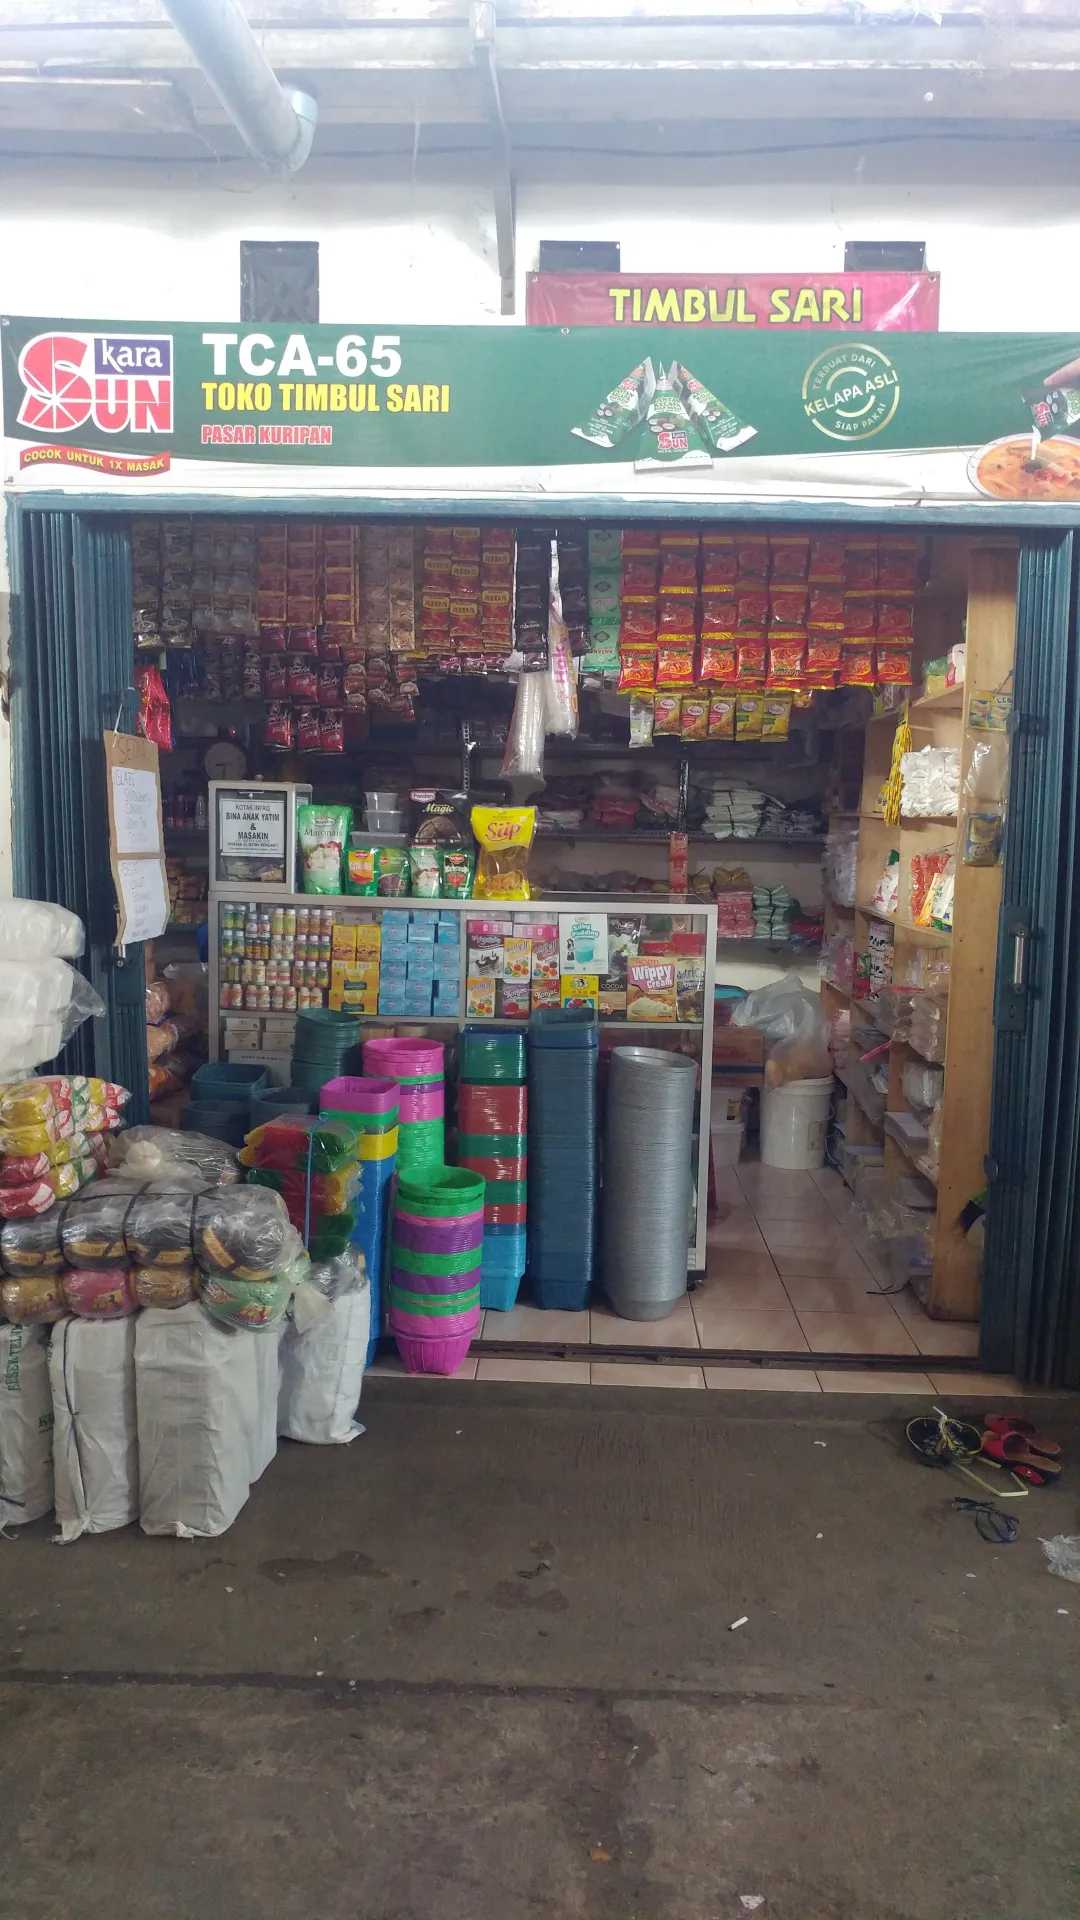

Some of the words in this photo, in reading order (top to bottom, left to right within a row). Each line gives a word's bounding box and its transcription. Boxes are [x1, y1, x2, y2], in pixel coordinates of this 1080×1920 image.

[608, 287, 757, 323] TIMBUL
[768, 286, 864, 323] SARI
[102, 339, 164, 374] kara
[202, 333, 401, 378] TCA-65
[812, 354, 848, 390] TERBUAT
[851, 353, 877, 368] DARI
[202, 382, 273, 412] TOKO
[279, 383, 380, 413] TIMBUL
[386, 384, 451, 413] SARI
[804, 384, 864, 416] KELAPA
[865, 370, 899, 393] ASLI
[835, 420, 859, 431] SIAP
[862, 403, 887, 428] PAKAI
[201, 424, 257, 444] PASAR
[258, 424, 333, 445] KURIPAN
[23, 448, 62, 463] COCOK
[66, 450, 105, 467] UNTUK
[109, 459, 123, 471] 1X
[126, 459, 165, 472] MASAK
[226, 812, 241, 820] BINA
[243, 812, 260, 821] ANAK
[261, 813, 280, 821] YATIM
[422, 803, 455, 815] Magic
[238, 831, 269, 840] MASAKIN
[571, 929, 600, 938] pudding
[572, 922, 592, 931] Silky
[632, 965, 672, 981] Wippy
[534, 988, 558, 999] Konjac
[646, 979, 673, 989] Cream
